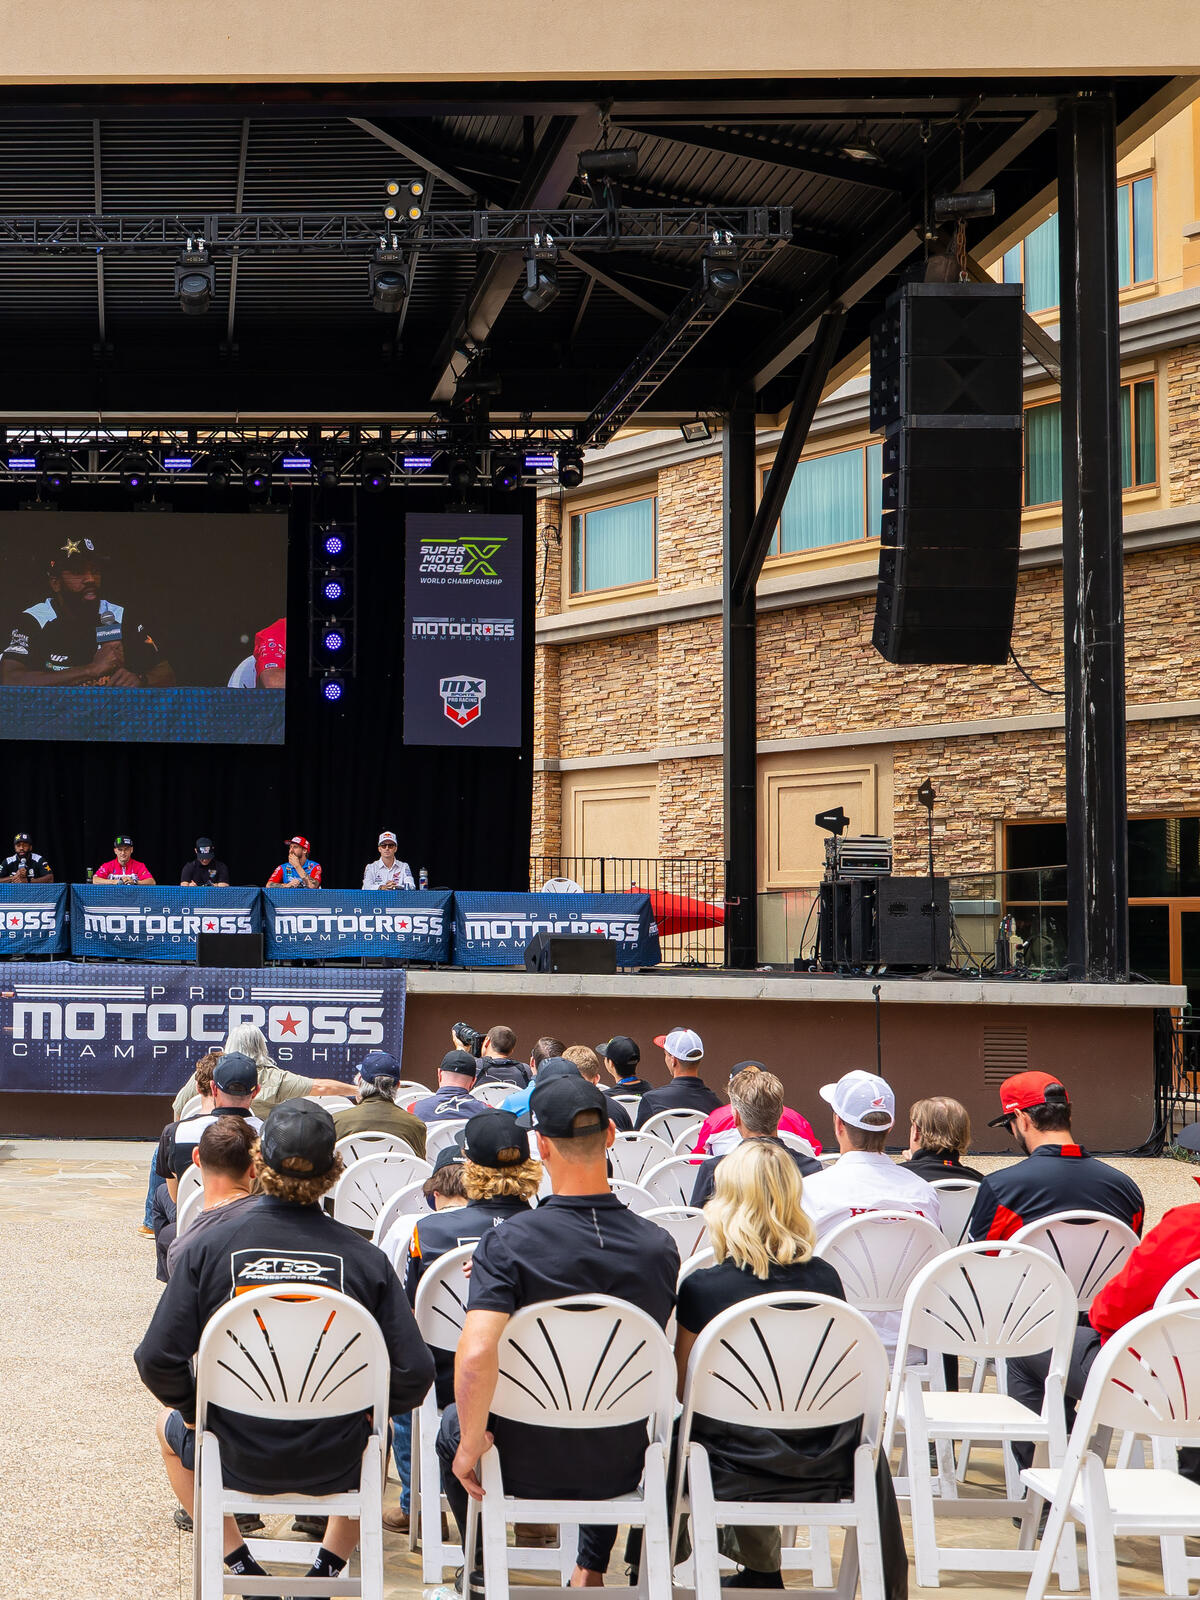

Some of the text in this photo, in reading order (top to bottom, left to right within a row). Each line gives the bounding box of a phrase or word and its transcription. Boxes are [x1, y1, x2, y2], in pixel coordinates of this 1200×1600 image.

[420, 546, 466, 555] SUPER
[422, 555, 464, 564] MOTO
[419, 564, 464, 573] CROSS
[412, 622, 515, 637] MOTOCROSS
[84, 914, 252, 934] MOTOCROSS
[275, 915, 443, 936] MOTOCROSS
[465, 921, 640, 941] MOTOCROSS
[84, 932, 197, 942] CHAMPION
[276, 934, 442, 944] CHAMPIONSHIP
[152, 986, 245, 1000] PRO
[13, 1002, 384, 1044] MOTOCROSS
